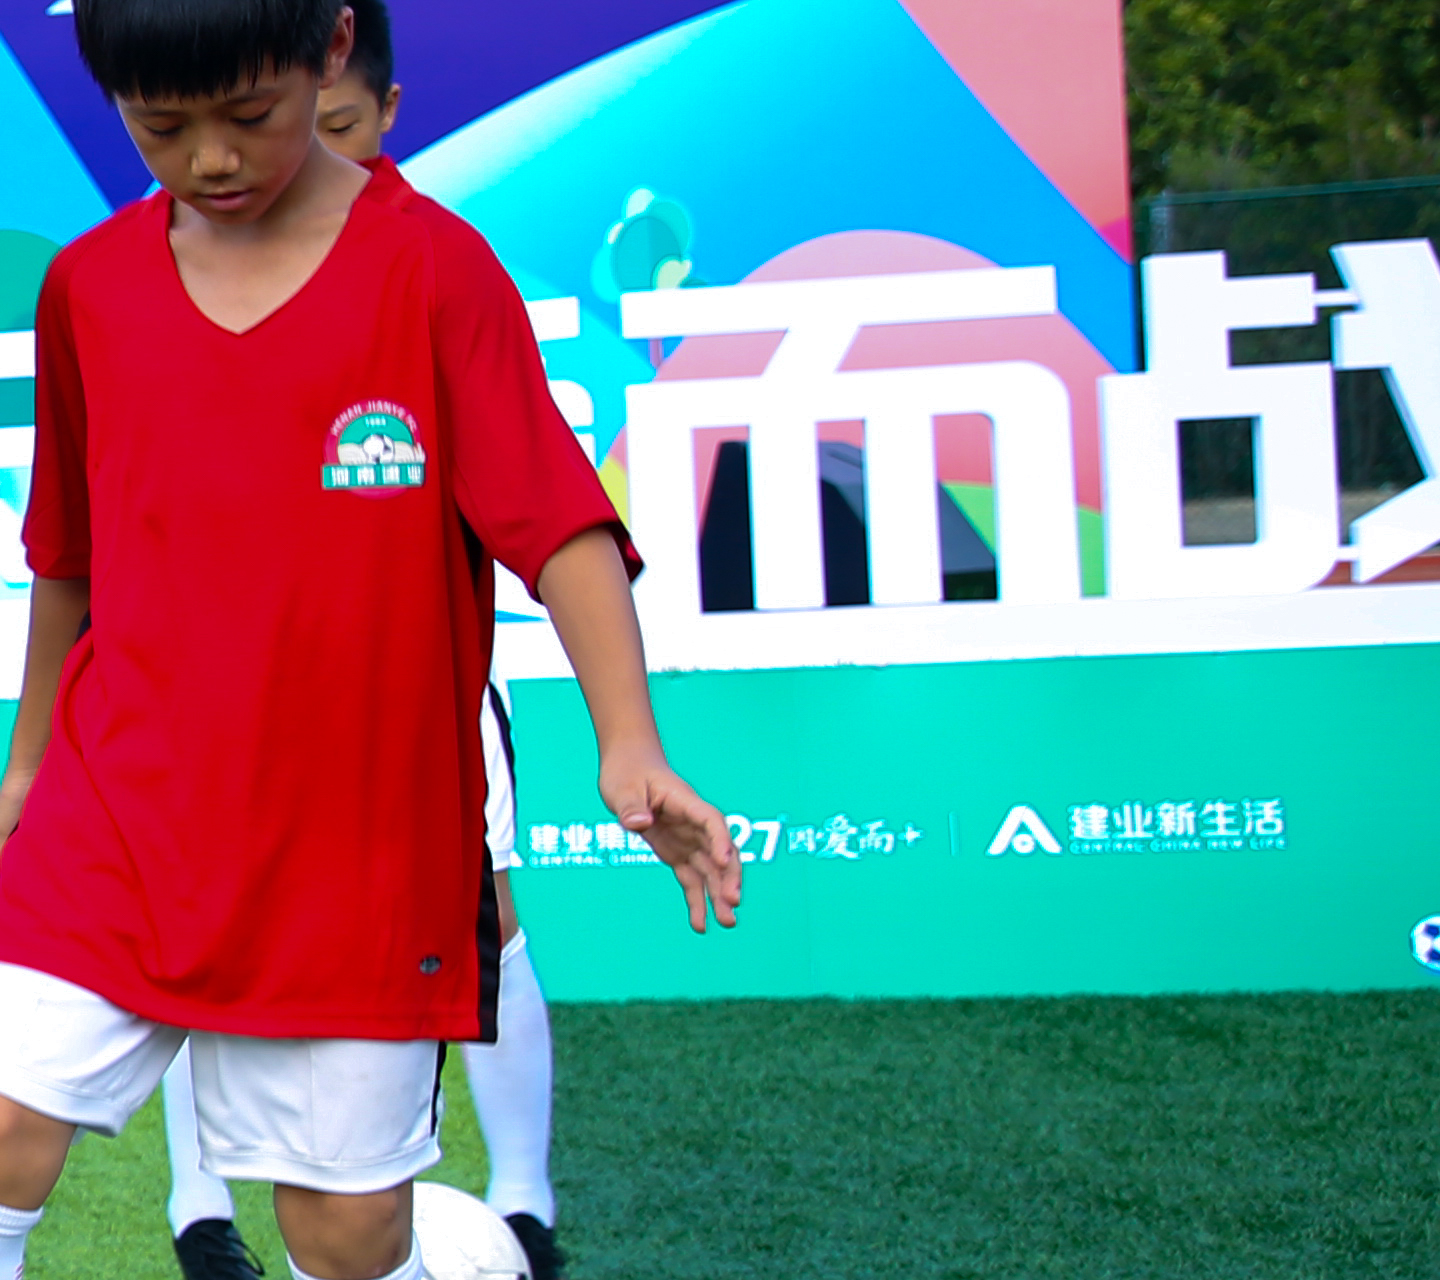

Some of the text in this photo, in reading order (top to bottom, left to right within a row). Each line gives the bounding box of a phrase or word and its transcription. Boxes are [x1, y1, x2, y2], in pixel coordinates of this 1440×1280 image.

[1068, 798, 1284, 839] 建业新生活
